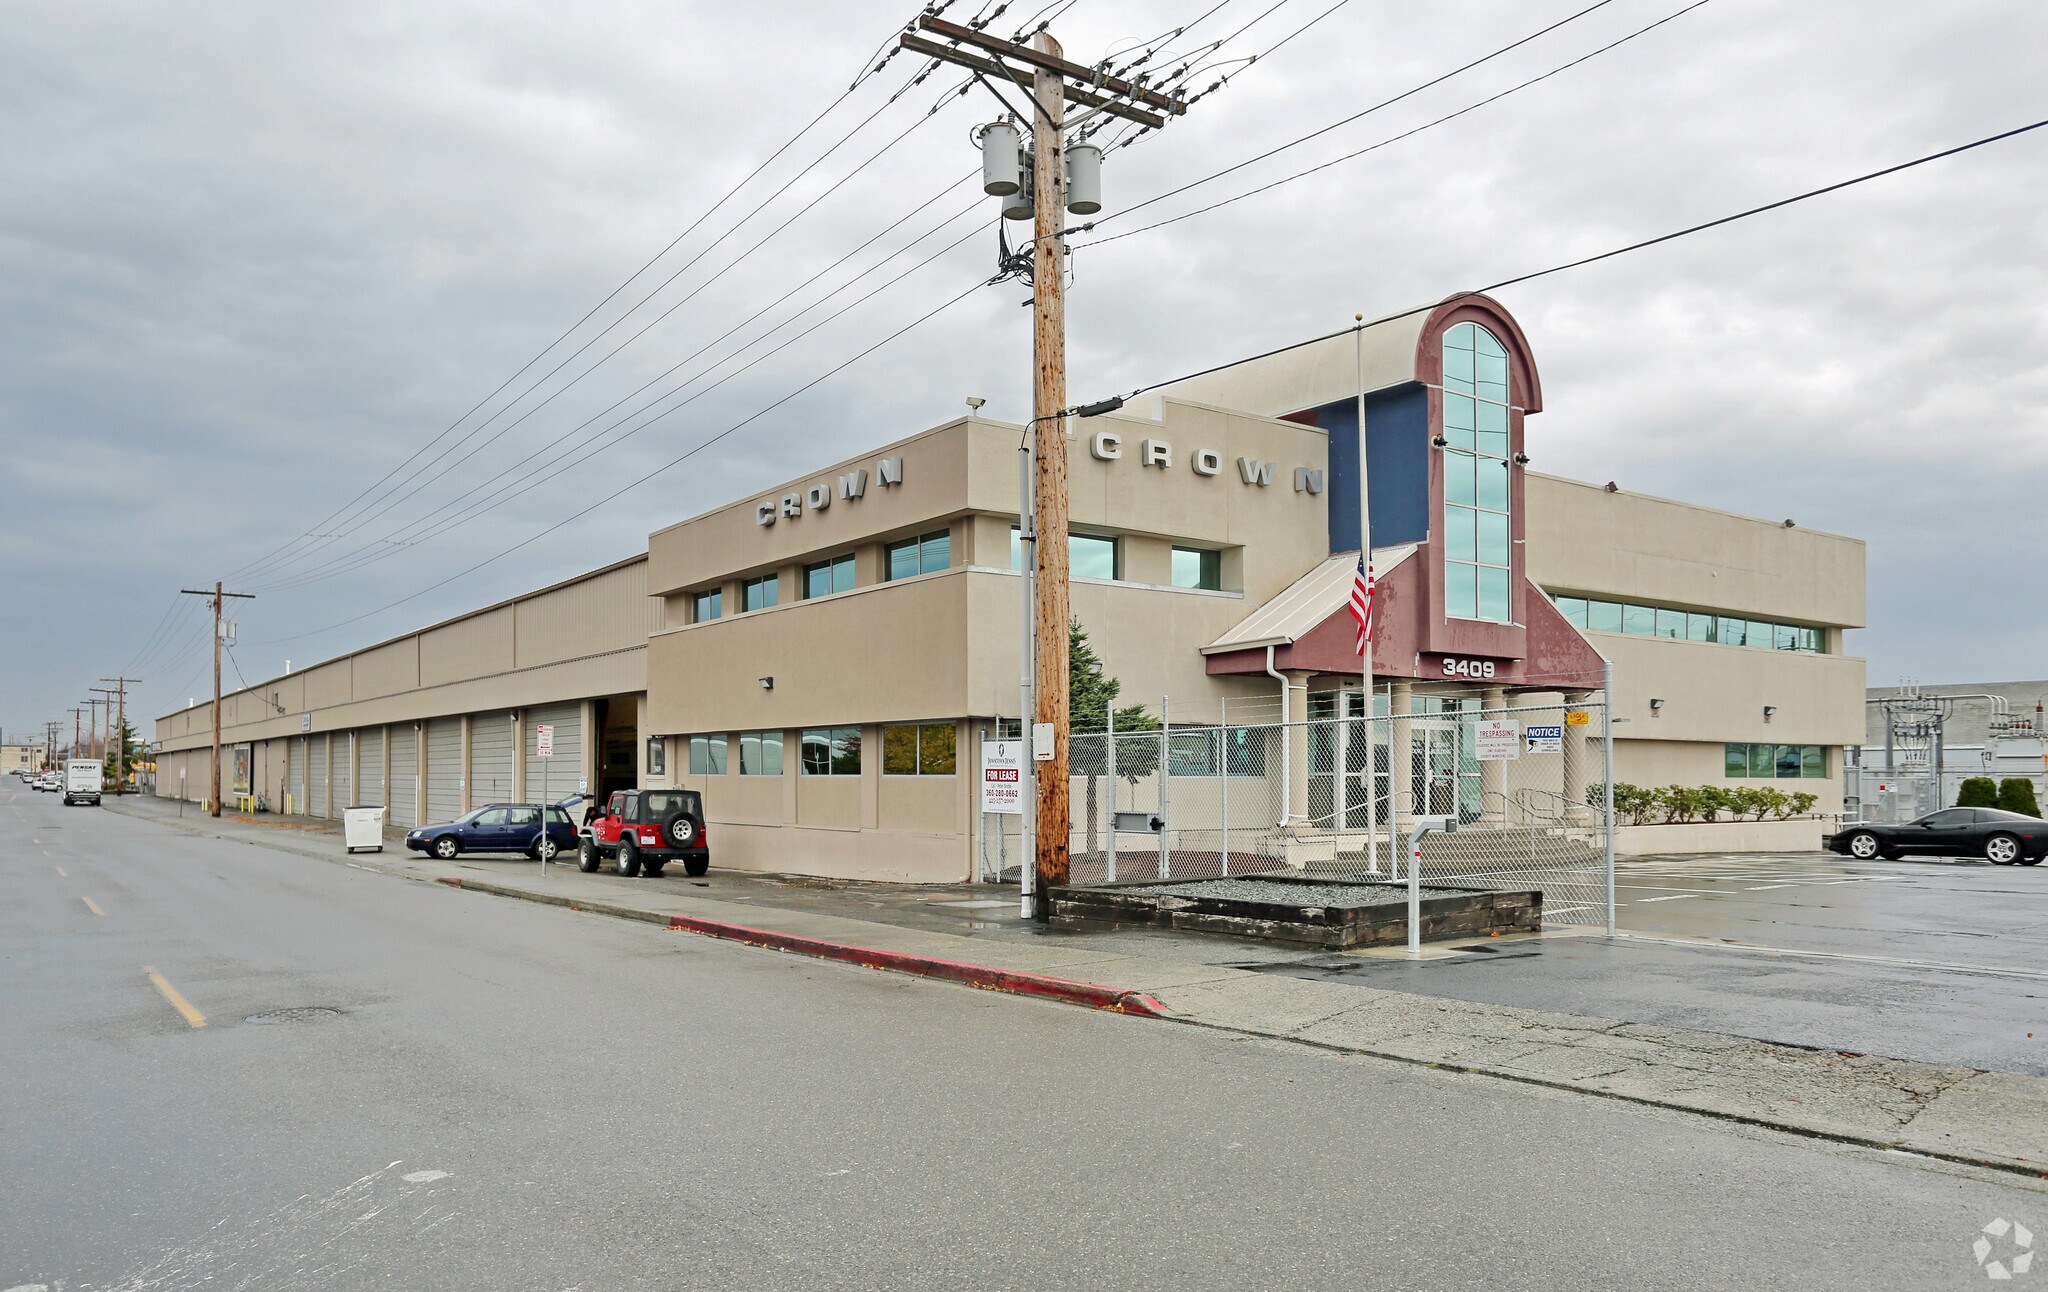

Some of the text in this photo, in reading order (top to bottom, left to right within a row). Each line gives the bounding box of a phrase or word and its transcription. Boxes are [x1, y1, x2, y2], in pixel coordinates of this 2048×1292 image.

[1090, 431, 1324, 495] CROWN
[756, 456, 903, 527] CROWN
[1442, 658, 1496, 678] 3409
[1479, 730, 1515, 738] TRESPASSING
[1528, 728, 1560, 737] NOTICE
[987, 770, 1017, 780] FOR LEASE
[986, 789, 1018, 797] 360-280-0662
